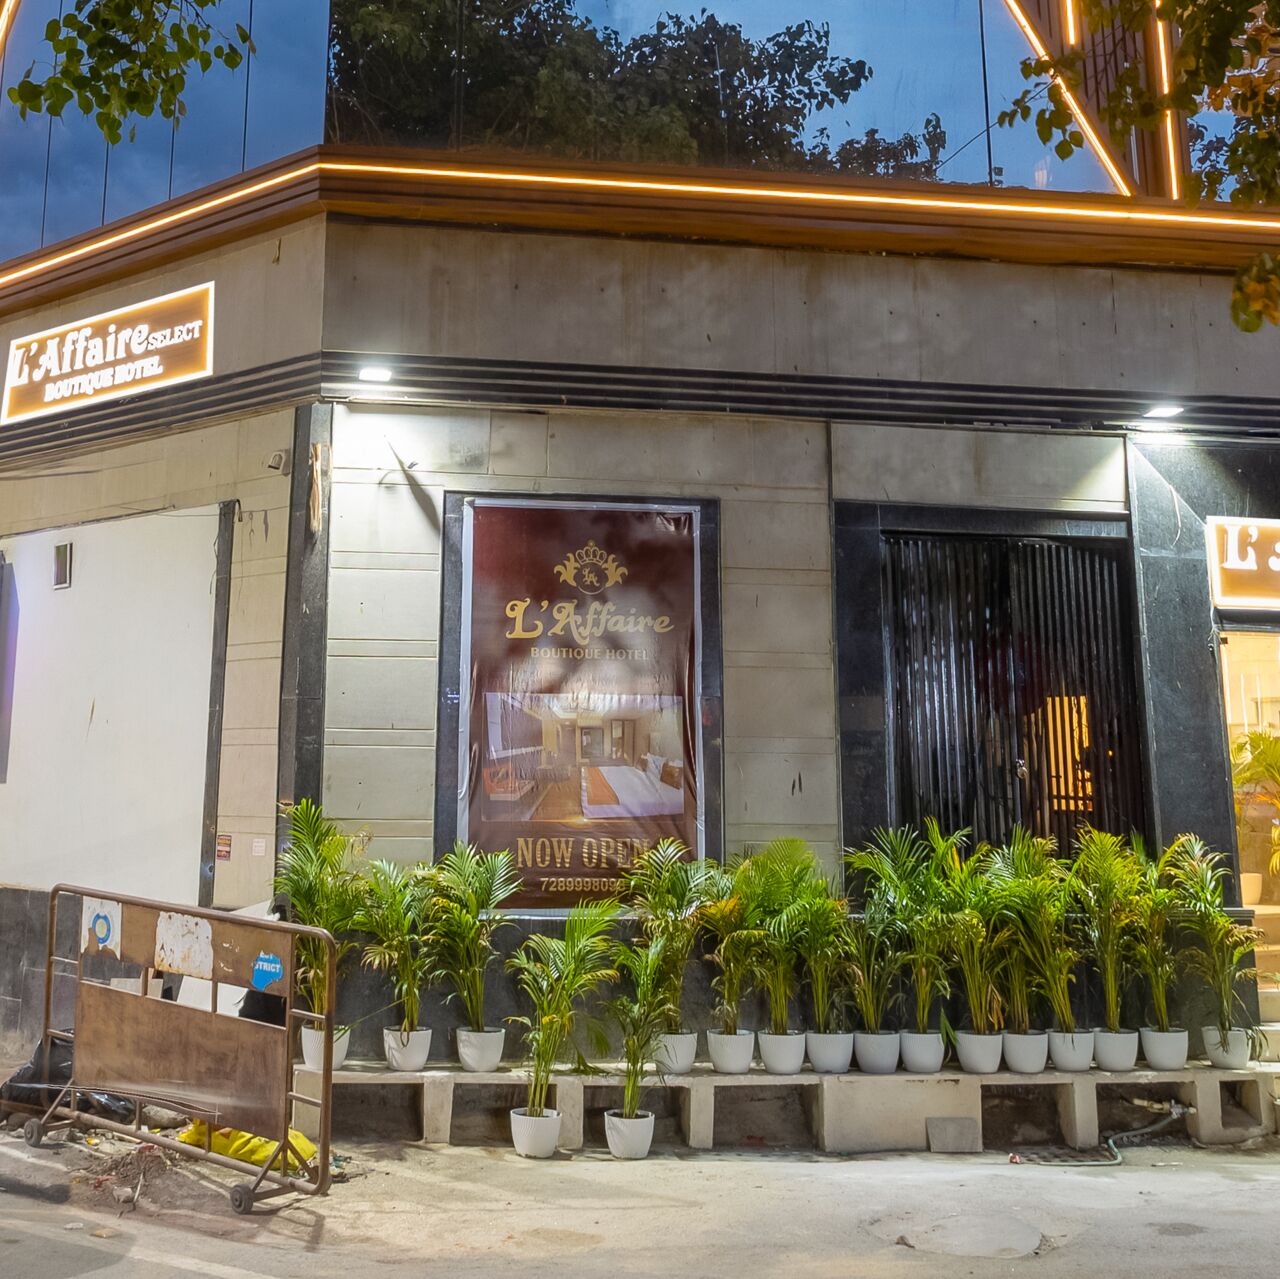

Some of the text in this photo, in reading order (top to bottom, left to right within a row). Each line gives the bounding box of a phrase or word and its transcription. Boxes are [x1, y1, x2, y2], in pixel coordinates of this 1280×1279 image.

[147, 320, 203, 350] SELECT
[44, 356, 164, 403] BOUTIQUE HOTEL
[505, 597, 676, 646] L'Affaire
[530, 647, 650, 661] BOUTIQUE HOTEL
[516, 837, 575, 868] NOW
